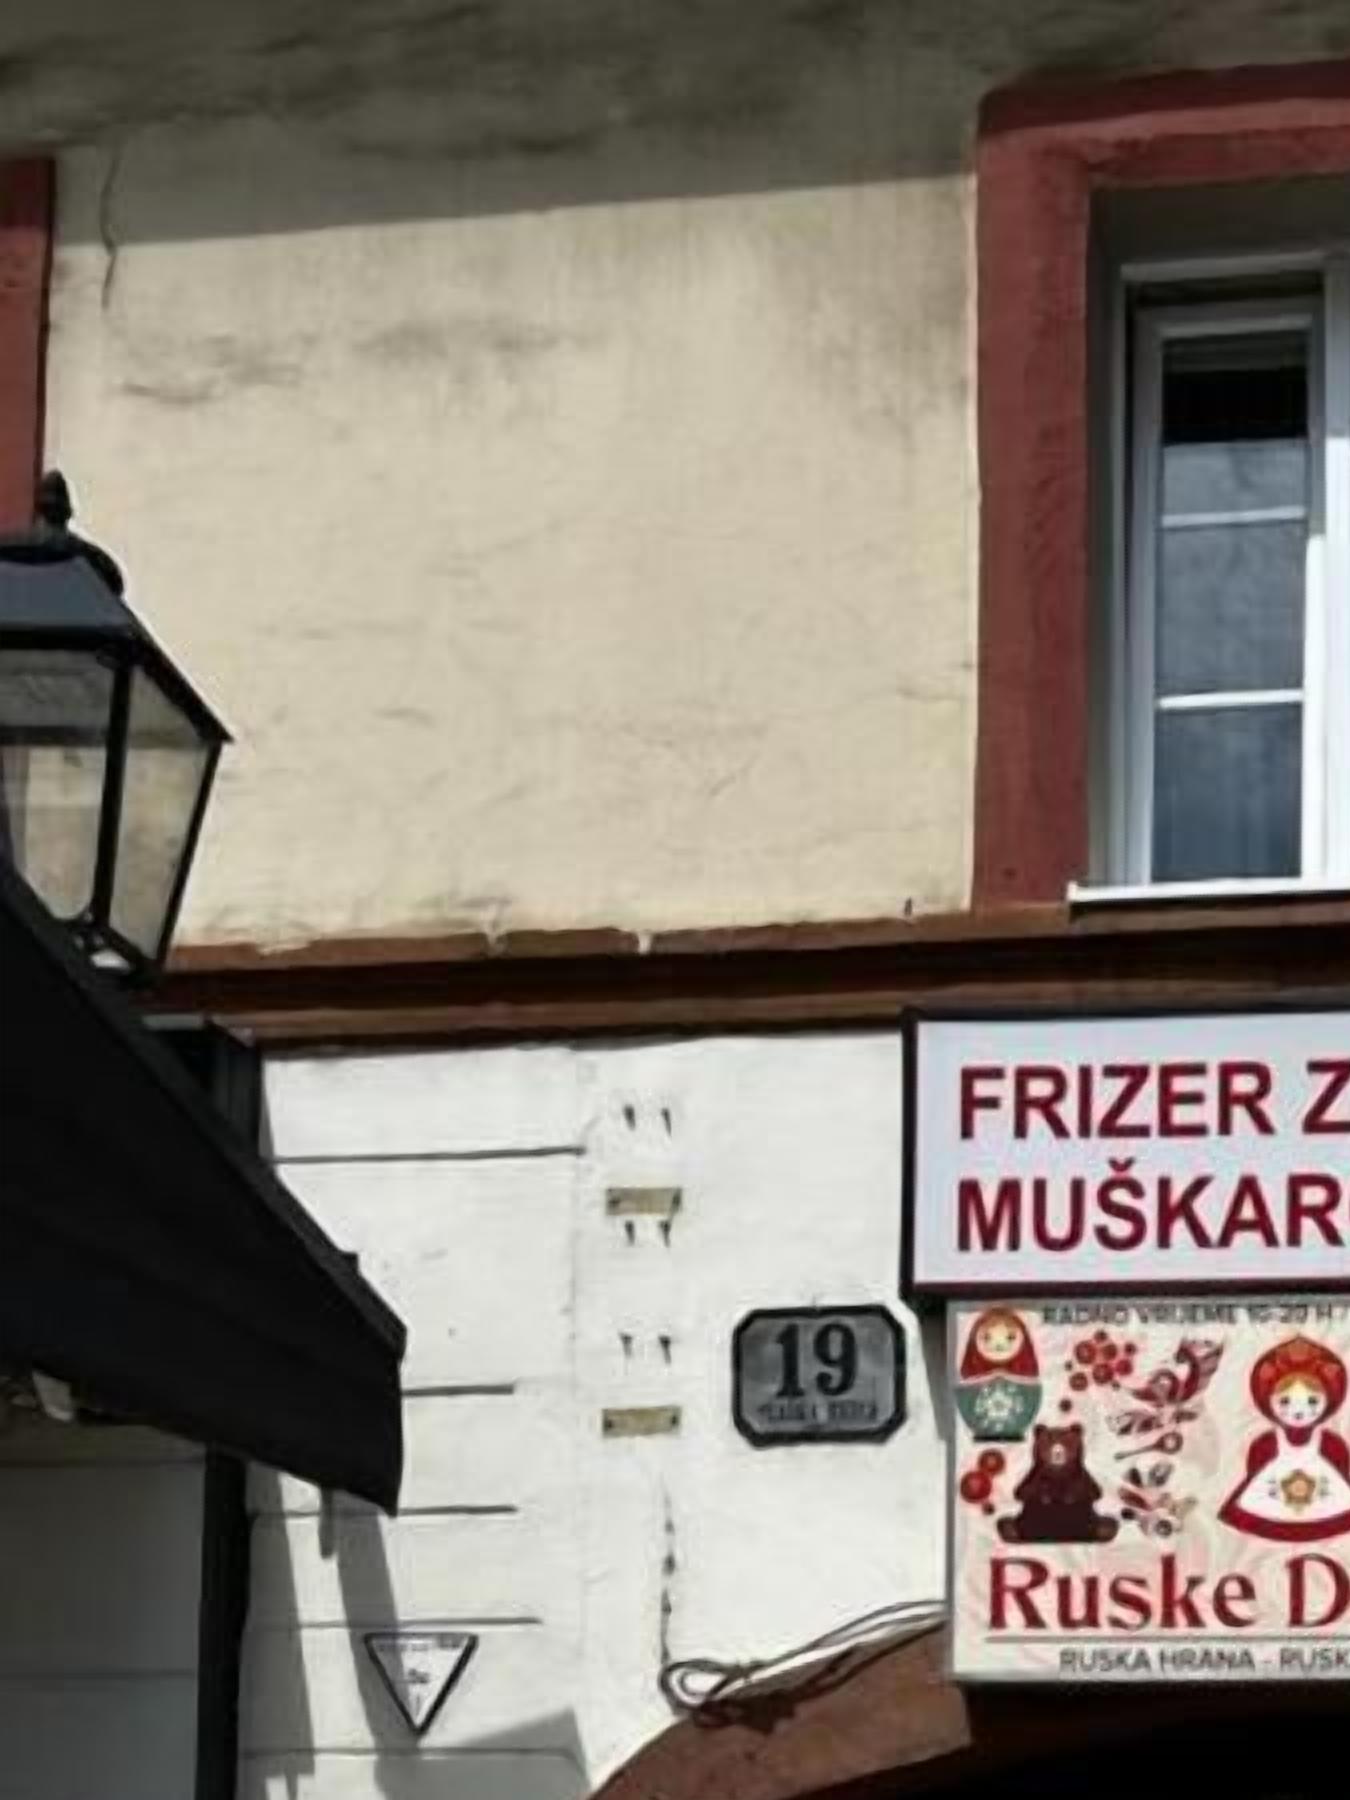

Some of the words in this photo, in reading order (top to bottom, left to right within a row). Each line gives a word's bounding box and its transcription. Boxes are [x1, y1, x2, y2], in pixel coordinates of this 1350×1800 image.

[960, 1060, 1275, 1140] FRIZER
[776, 1323, 857, 1397] 19
[987, 1554, 1257, 1632] Ruske
[1059, 1648, 1152, 1672] RUSKA
[1160, 1648, 1255, 1671] HRANA
